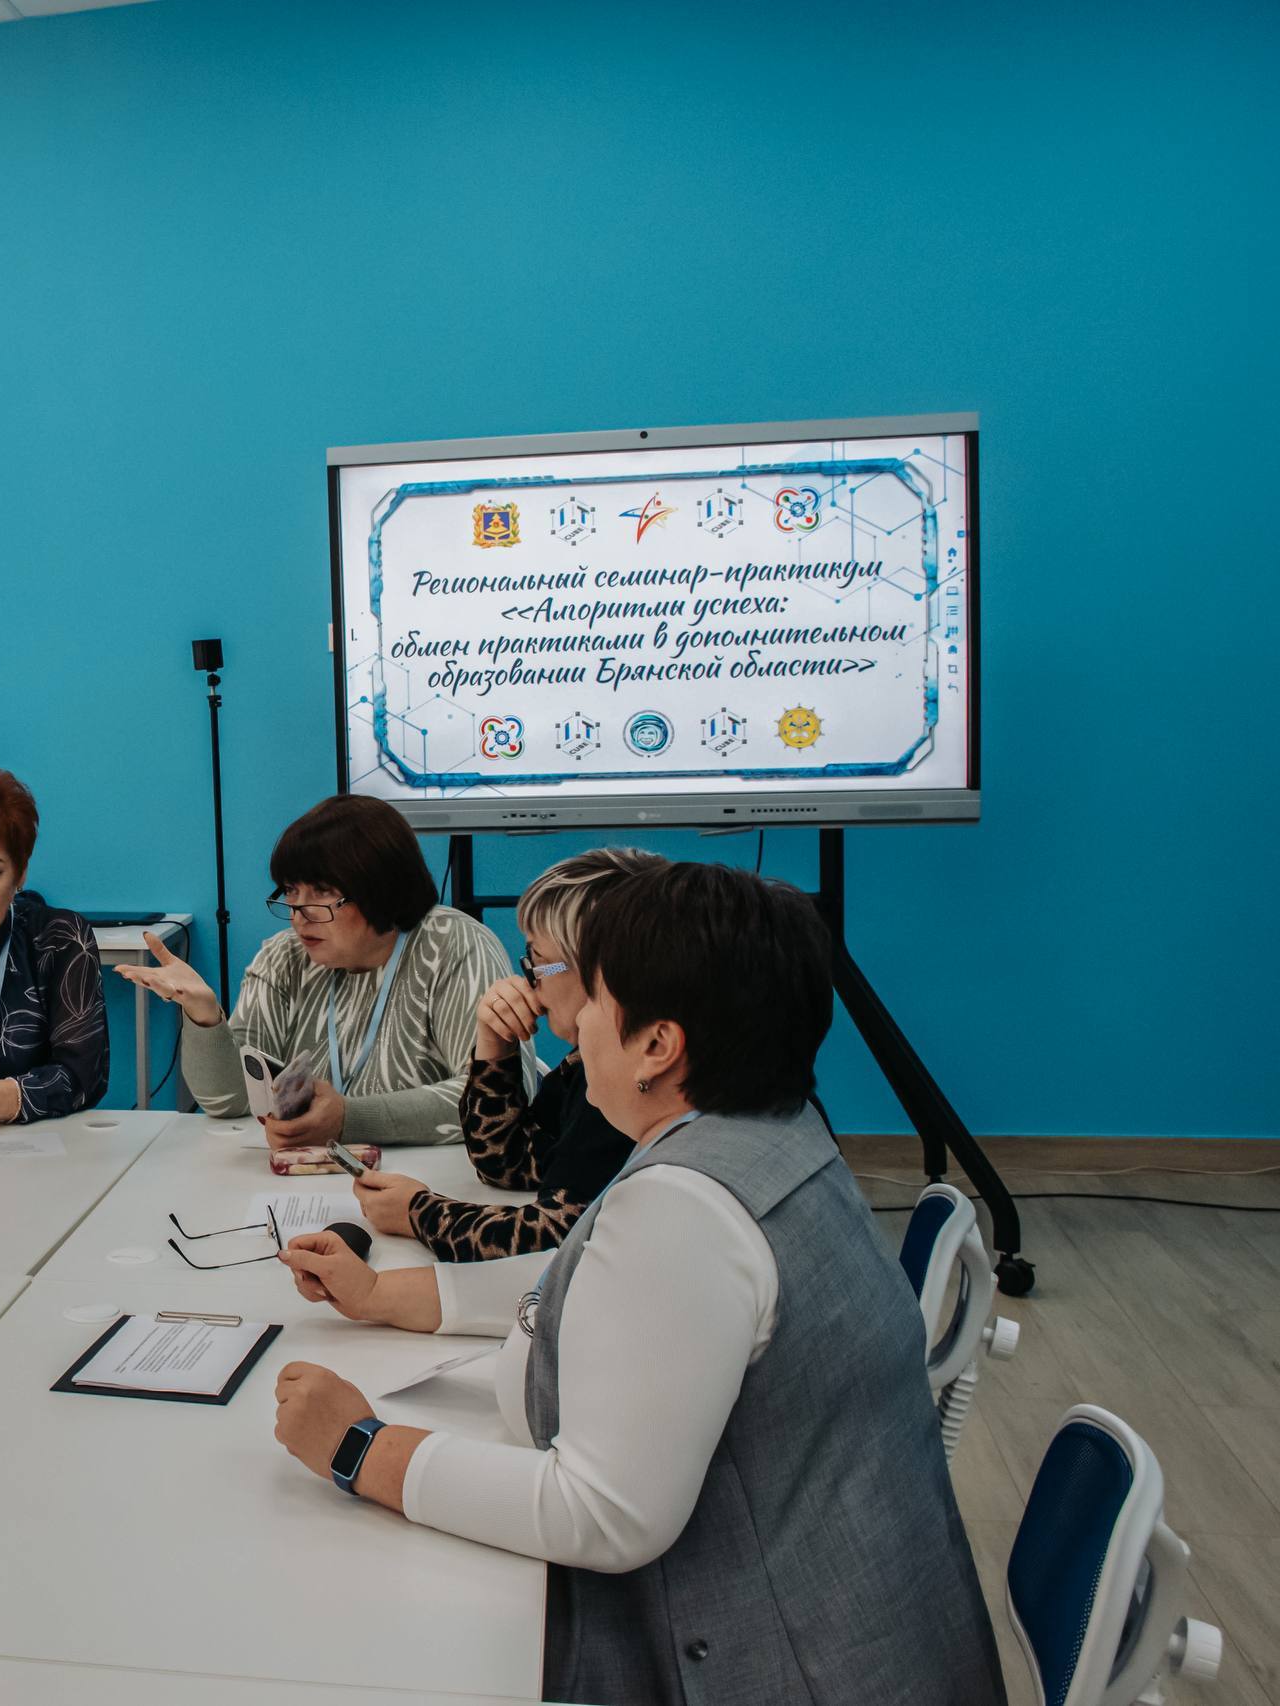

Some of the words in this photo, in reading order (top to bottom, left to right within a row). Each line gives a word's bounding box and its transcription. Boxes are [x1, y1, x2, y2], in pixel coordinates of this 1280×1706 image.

[412, 564, 588, 597] Региональный
[594, 560, 883, 594] семинар-практикум
[688, 596, 789, 626] успеха:
[391, 630, 469, 658] обмен
[478, 632, 645, 664] практиками
[653, 621, 668, 649] в
[669, 624, 907, 659] дополнительном
[428, 658, 586, 697] образовании
[596, 655, 725, 692] Брянской
